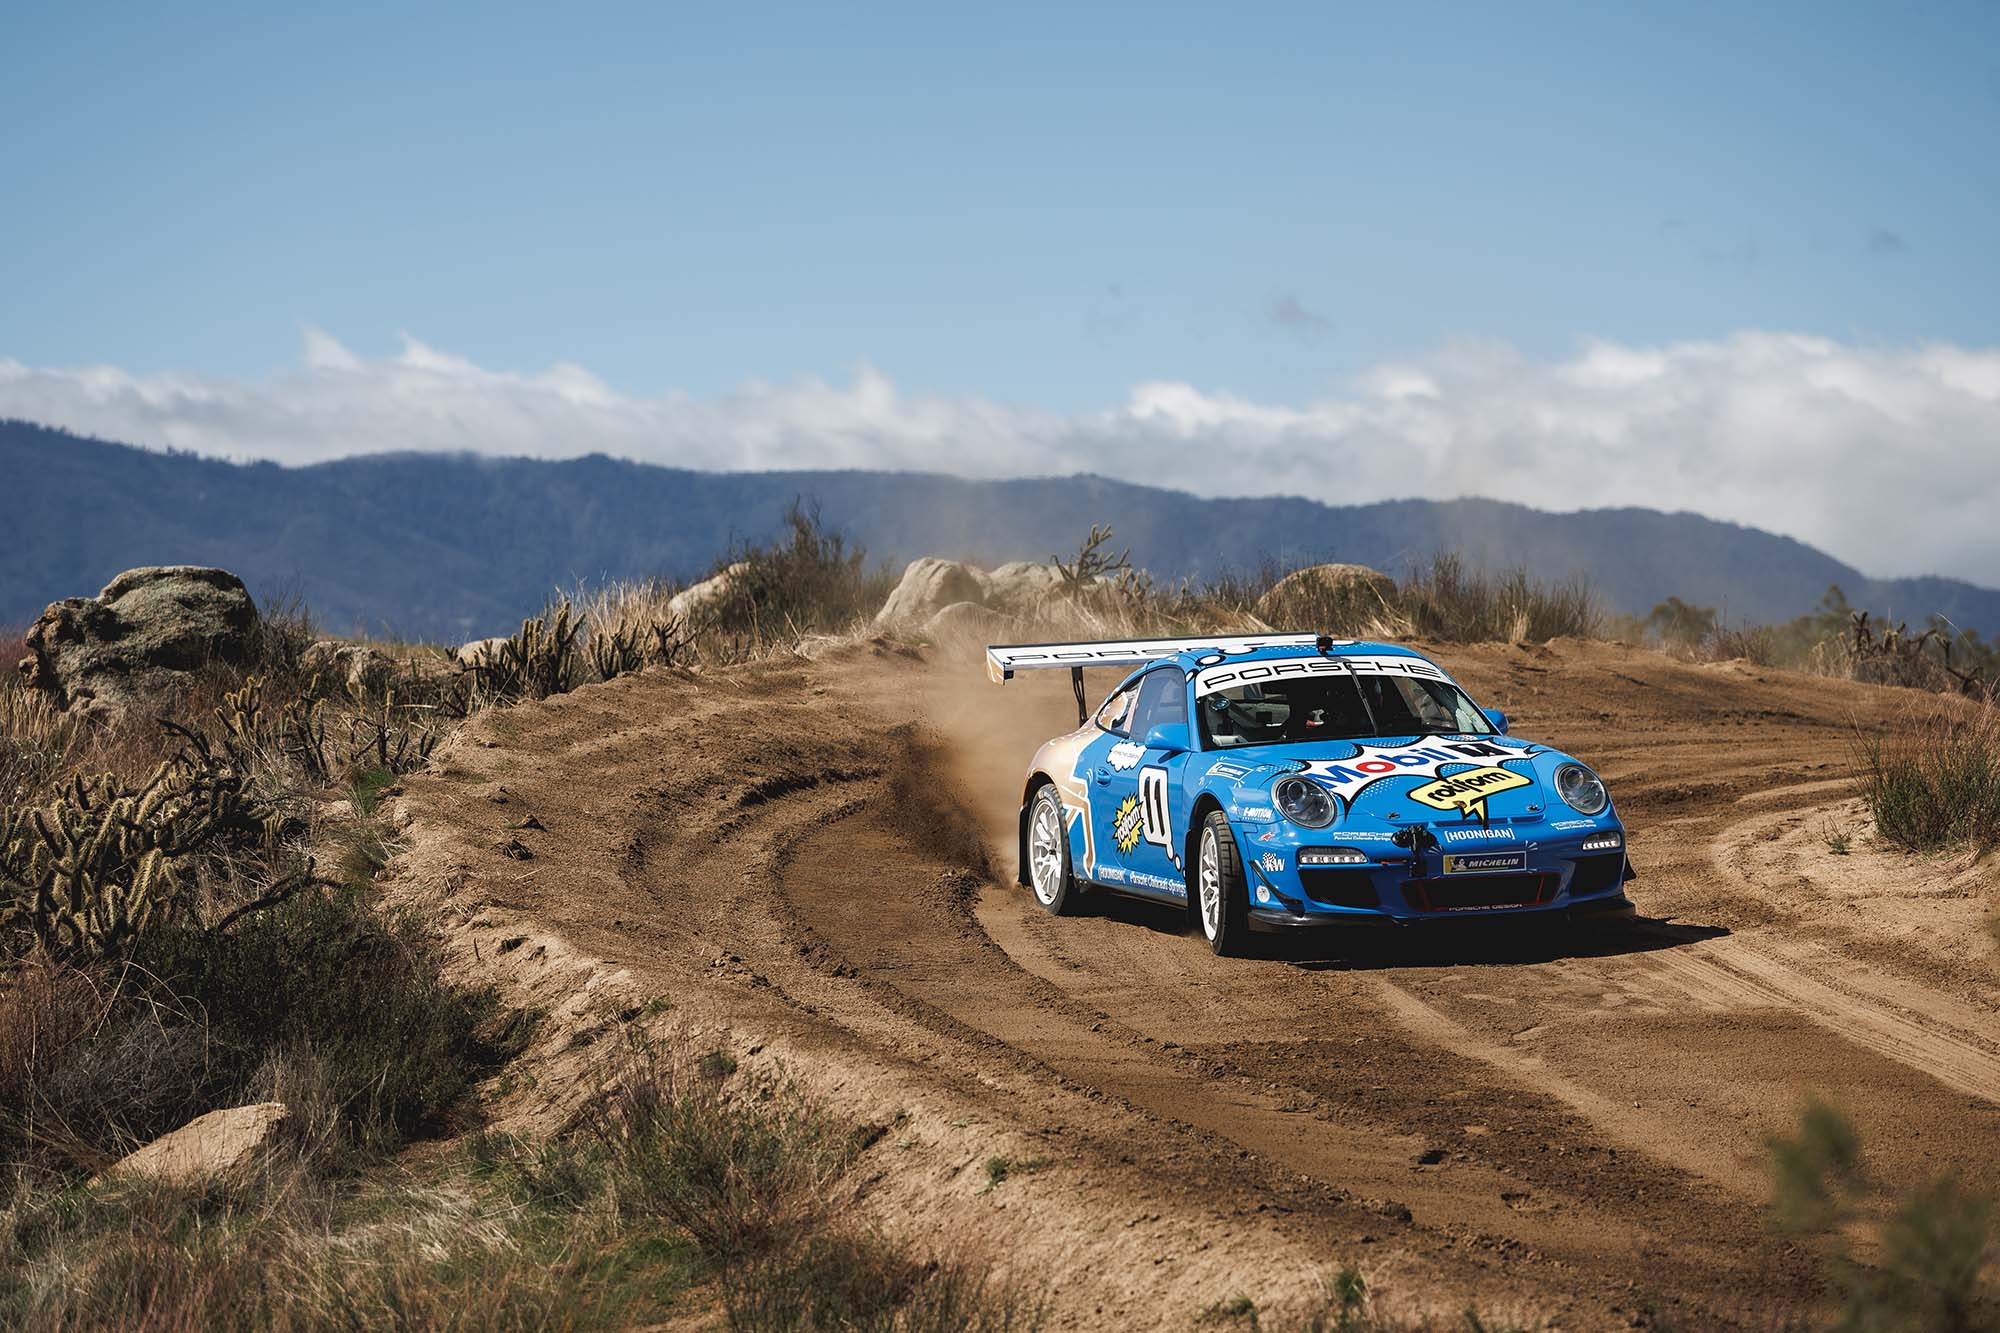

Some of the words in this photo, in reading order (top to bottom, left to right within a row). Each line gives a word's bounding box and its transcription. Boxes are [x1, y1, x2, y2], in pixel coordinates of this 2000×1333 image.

[1203, 661, 1440, 689] PORSCHE
[1304, 747, 1460, 790] Mobil
[1427, 772, 1513, 802] rotiform
[1143, 776, 1166, 837] 11
[1266, 859, 1285, 872] KW
[1468, 858, 1519, 868] MICHELIN
